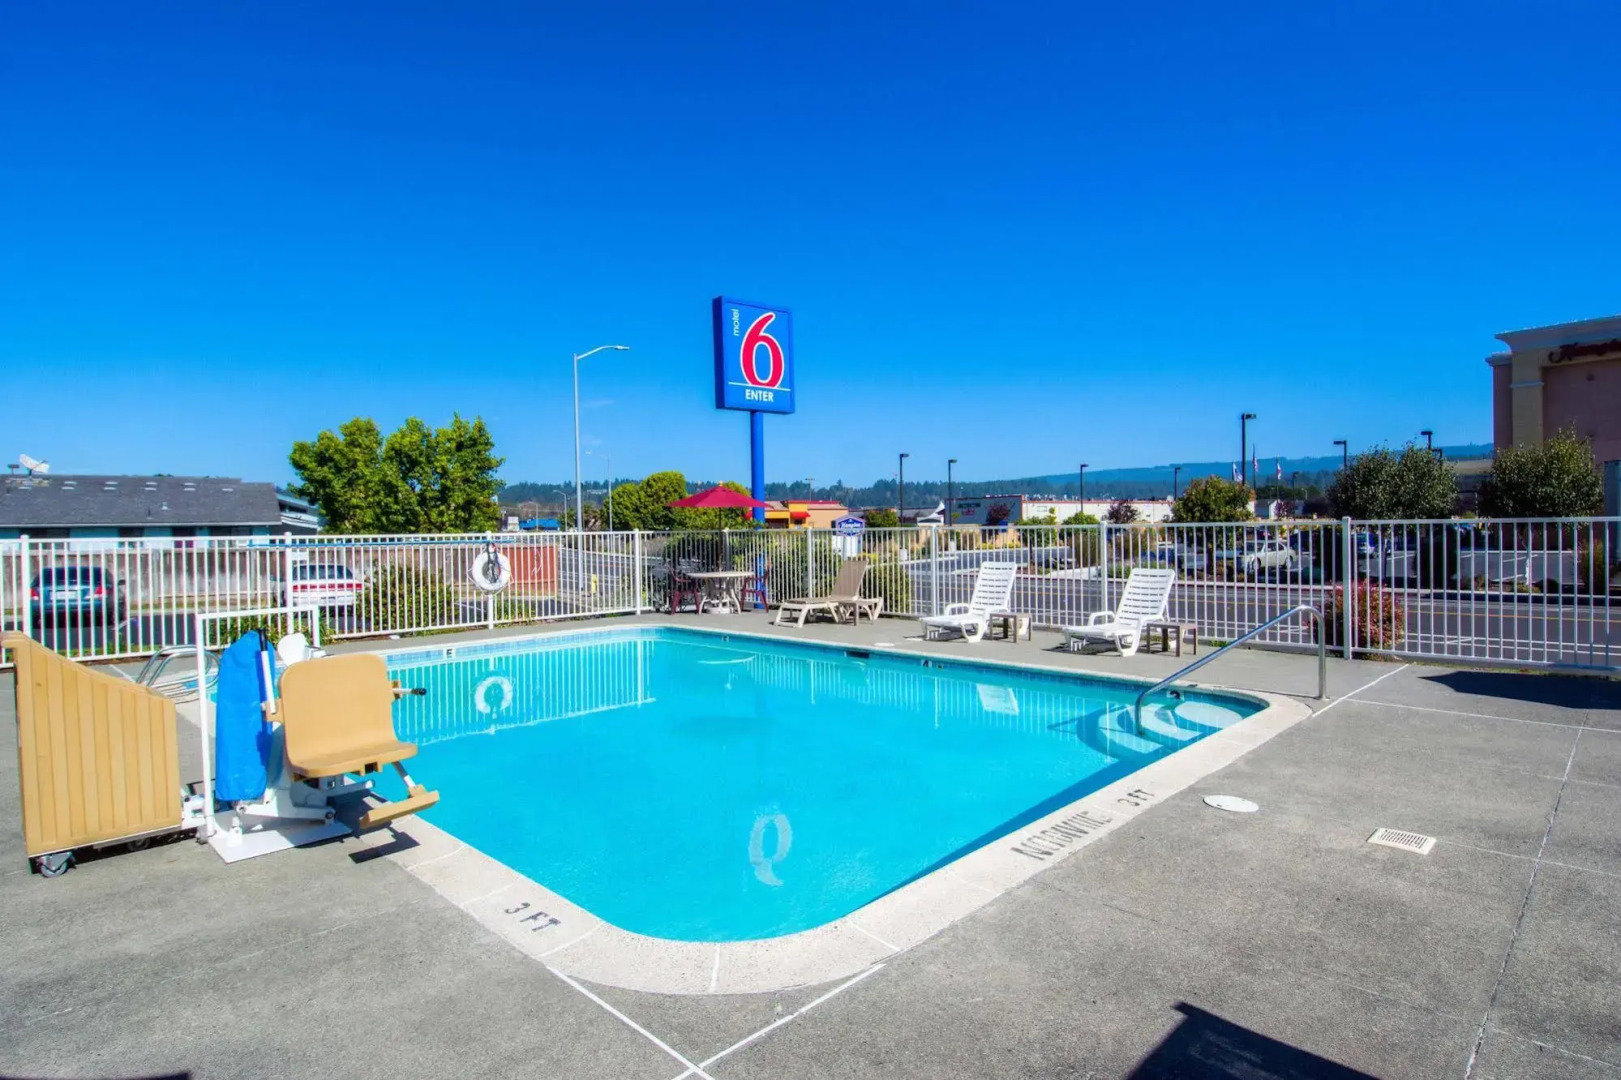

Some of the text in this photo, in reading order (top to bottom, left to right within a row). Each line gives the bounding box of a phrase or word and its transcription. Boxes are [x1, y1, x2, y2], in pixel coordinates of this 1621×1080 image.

[740, 312, 784, 389] 6
[745, 389, 774, 402] ENTER
[1117, 789, 1155, 807] 3 FT
[504, 902, 562, 932] 3 FT
